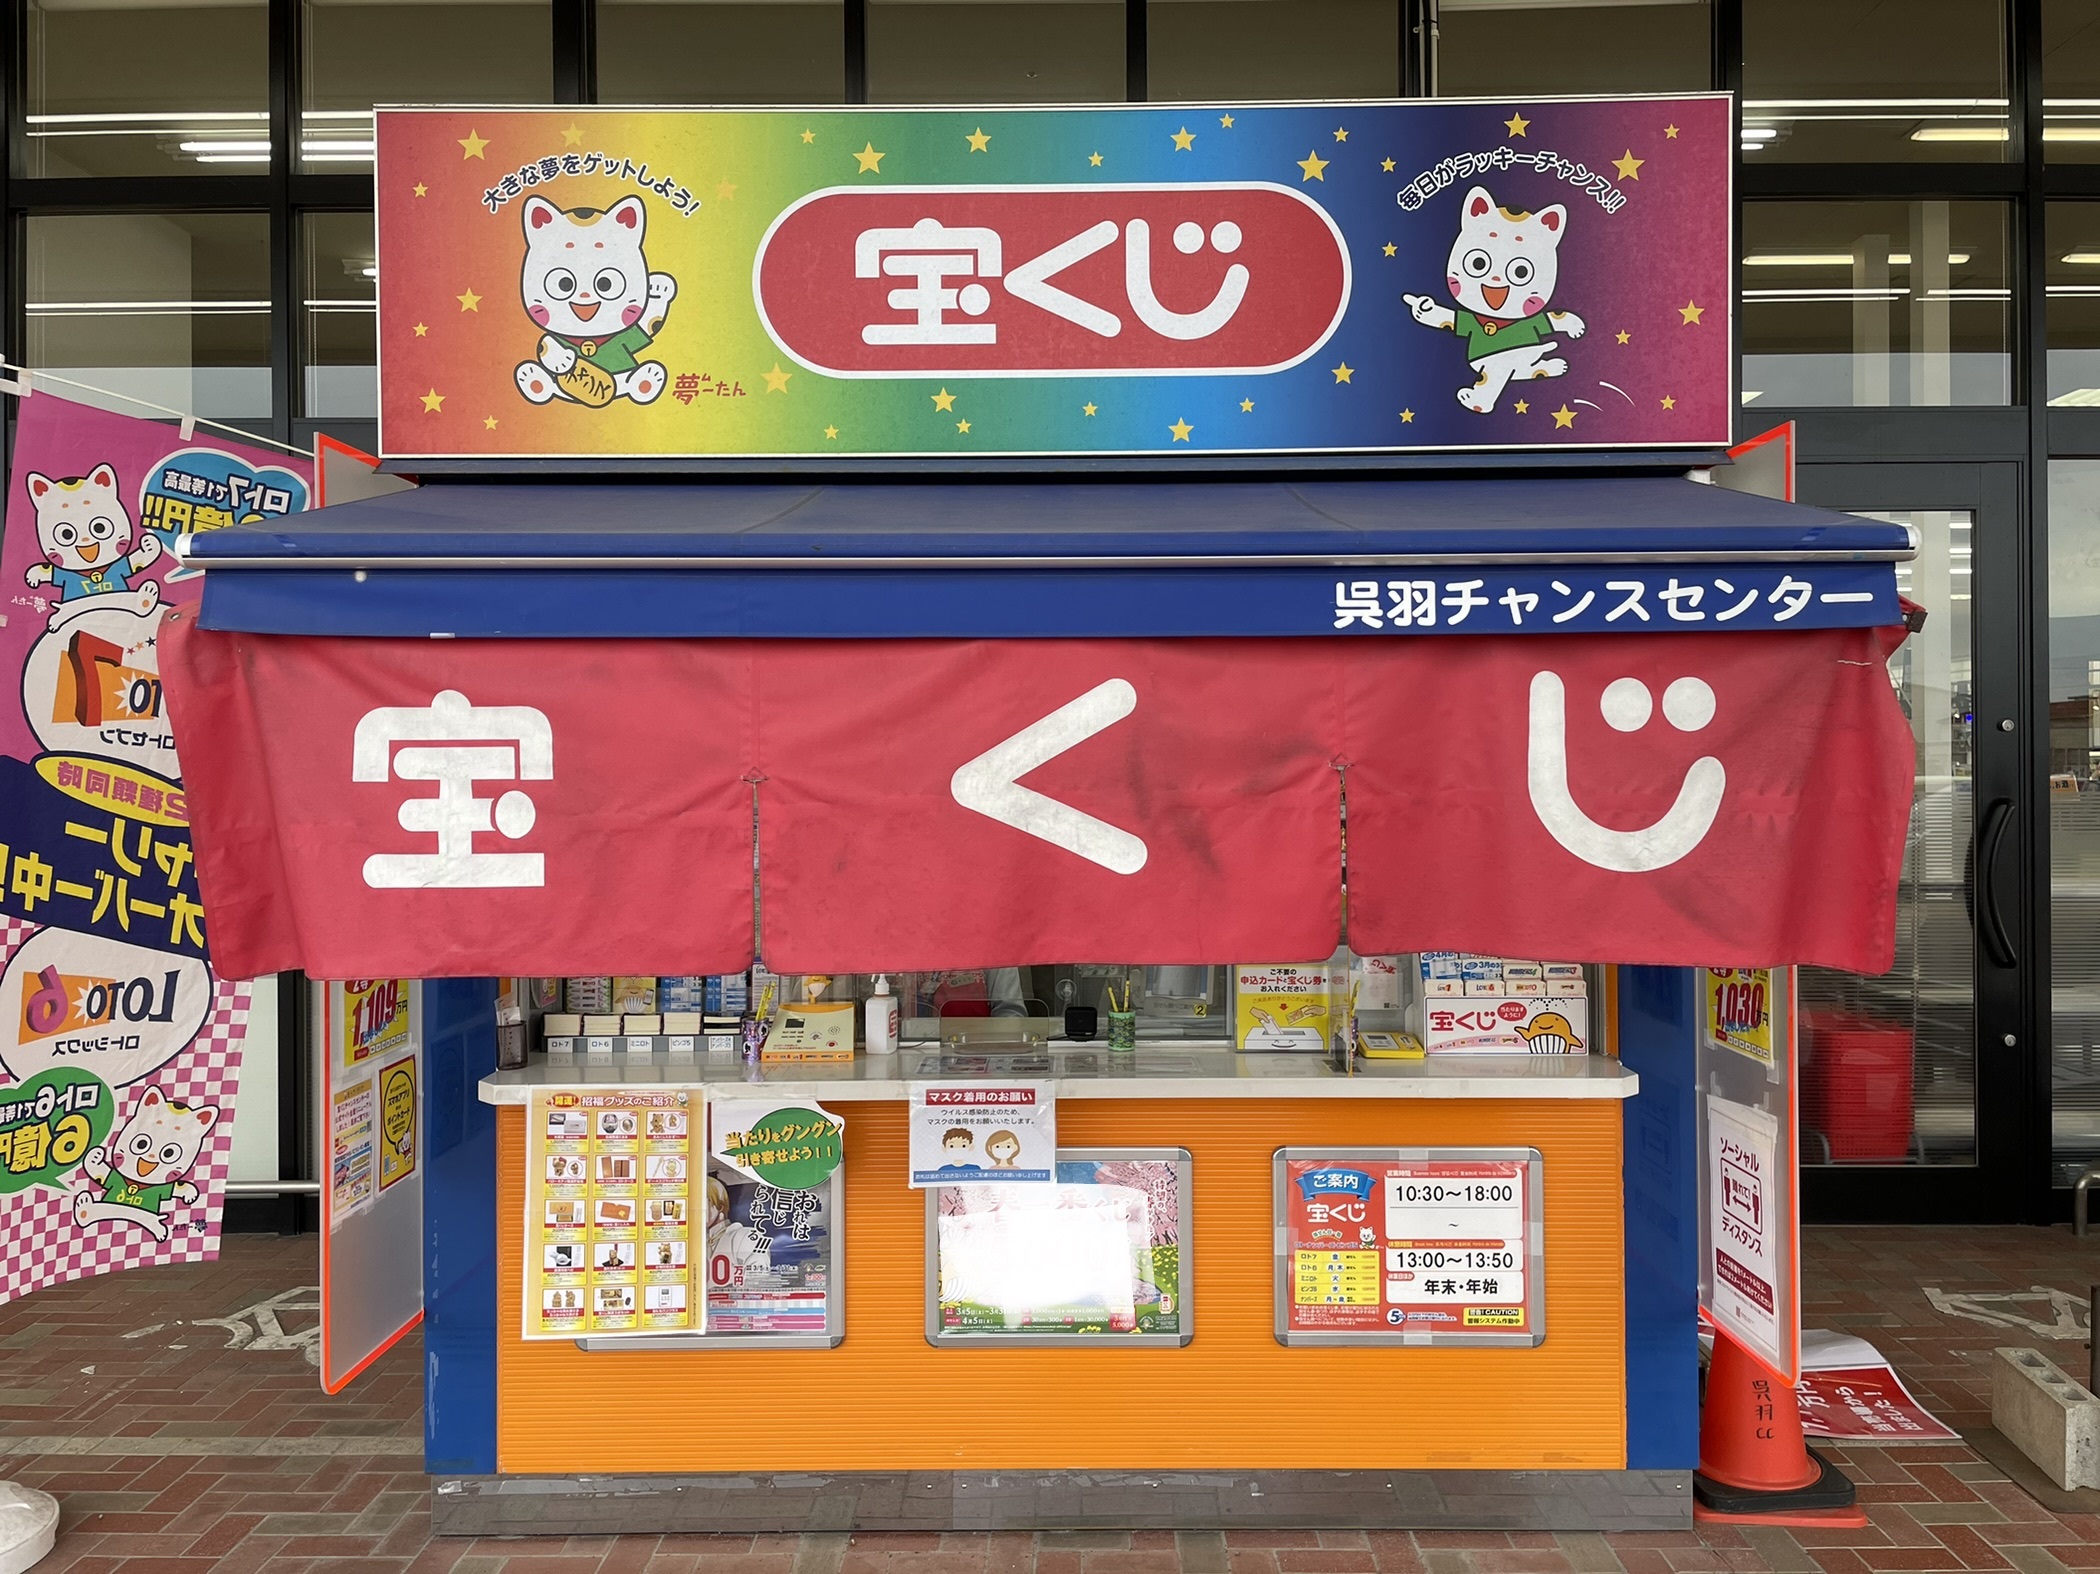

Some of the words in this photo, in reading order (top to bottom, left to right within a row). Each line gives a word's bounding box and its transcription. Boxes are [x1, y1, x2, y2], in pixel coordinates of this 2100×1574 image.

[483, 154, 701, 217] 大きな夢をゲットしよう!
[854, 217, 1250, 345] 宝くじ
[1333, 576, 1874, 629] 呉羽チャンスセンター
[1196, 1005, 1204, 1016] 2
[1429, 1010, 1497, 1031] 宝くじ
[581, 1095, 675, 1108] 招福グッズのご紹介
[929, 1092, 1033, 1102] マスク着用のお願い
[725, 1121, 842, 1149] 当たりをグングン
[1720, 1137, 1760, 1173] ソーシャル
[1313, 1173, 1359, 1189] ご案内
[1306, 1203, 1366, 1223] 宝くじ
[1722, 1216, 1763, 1257] ディスタンス
[1424, 1279, 1498, 1294] 年末・年始
